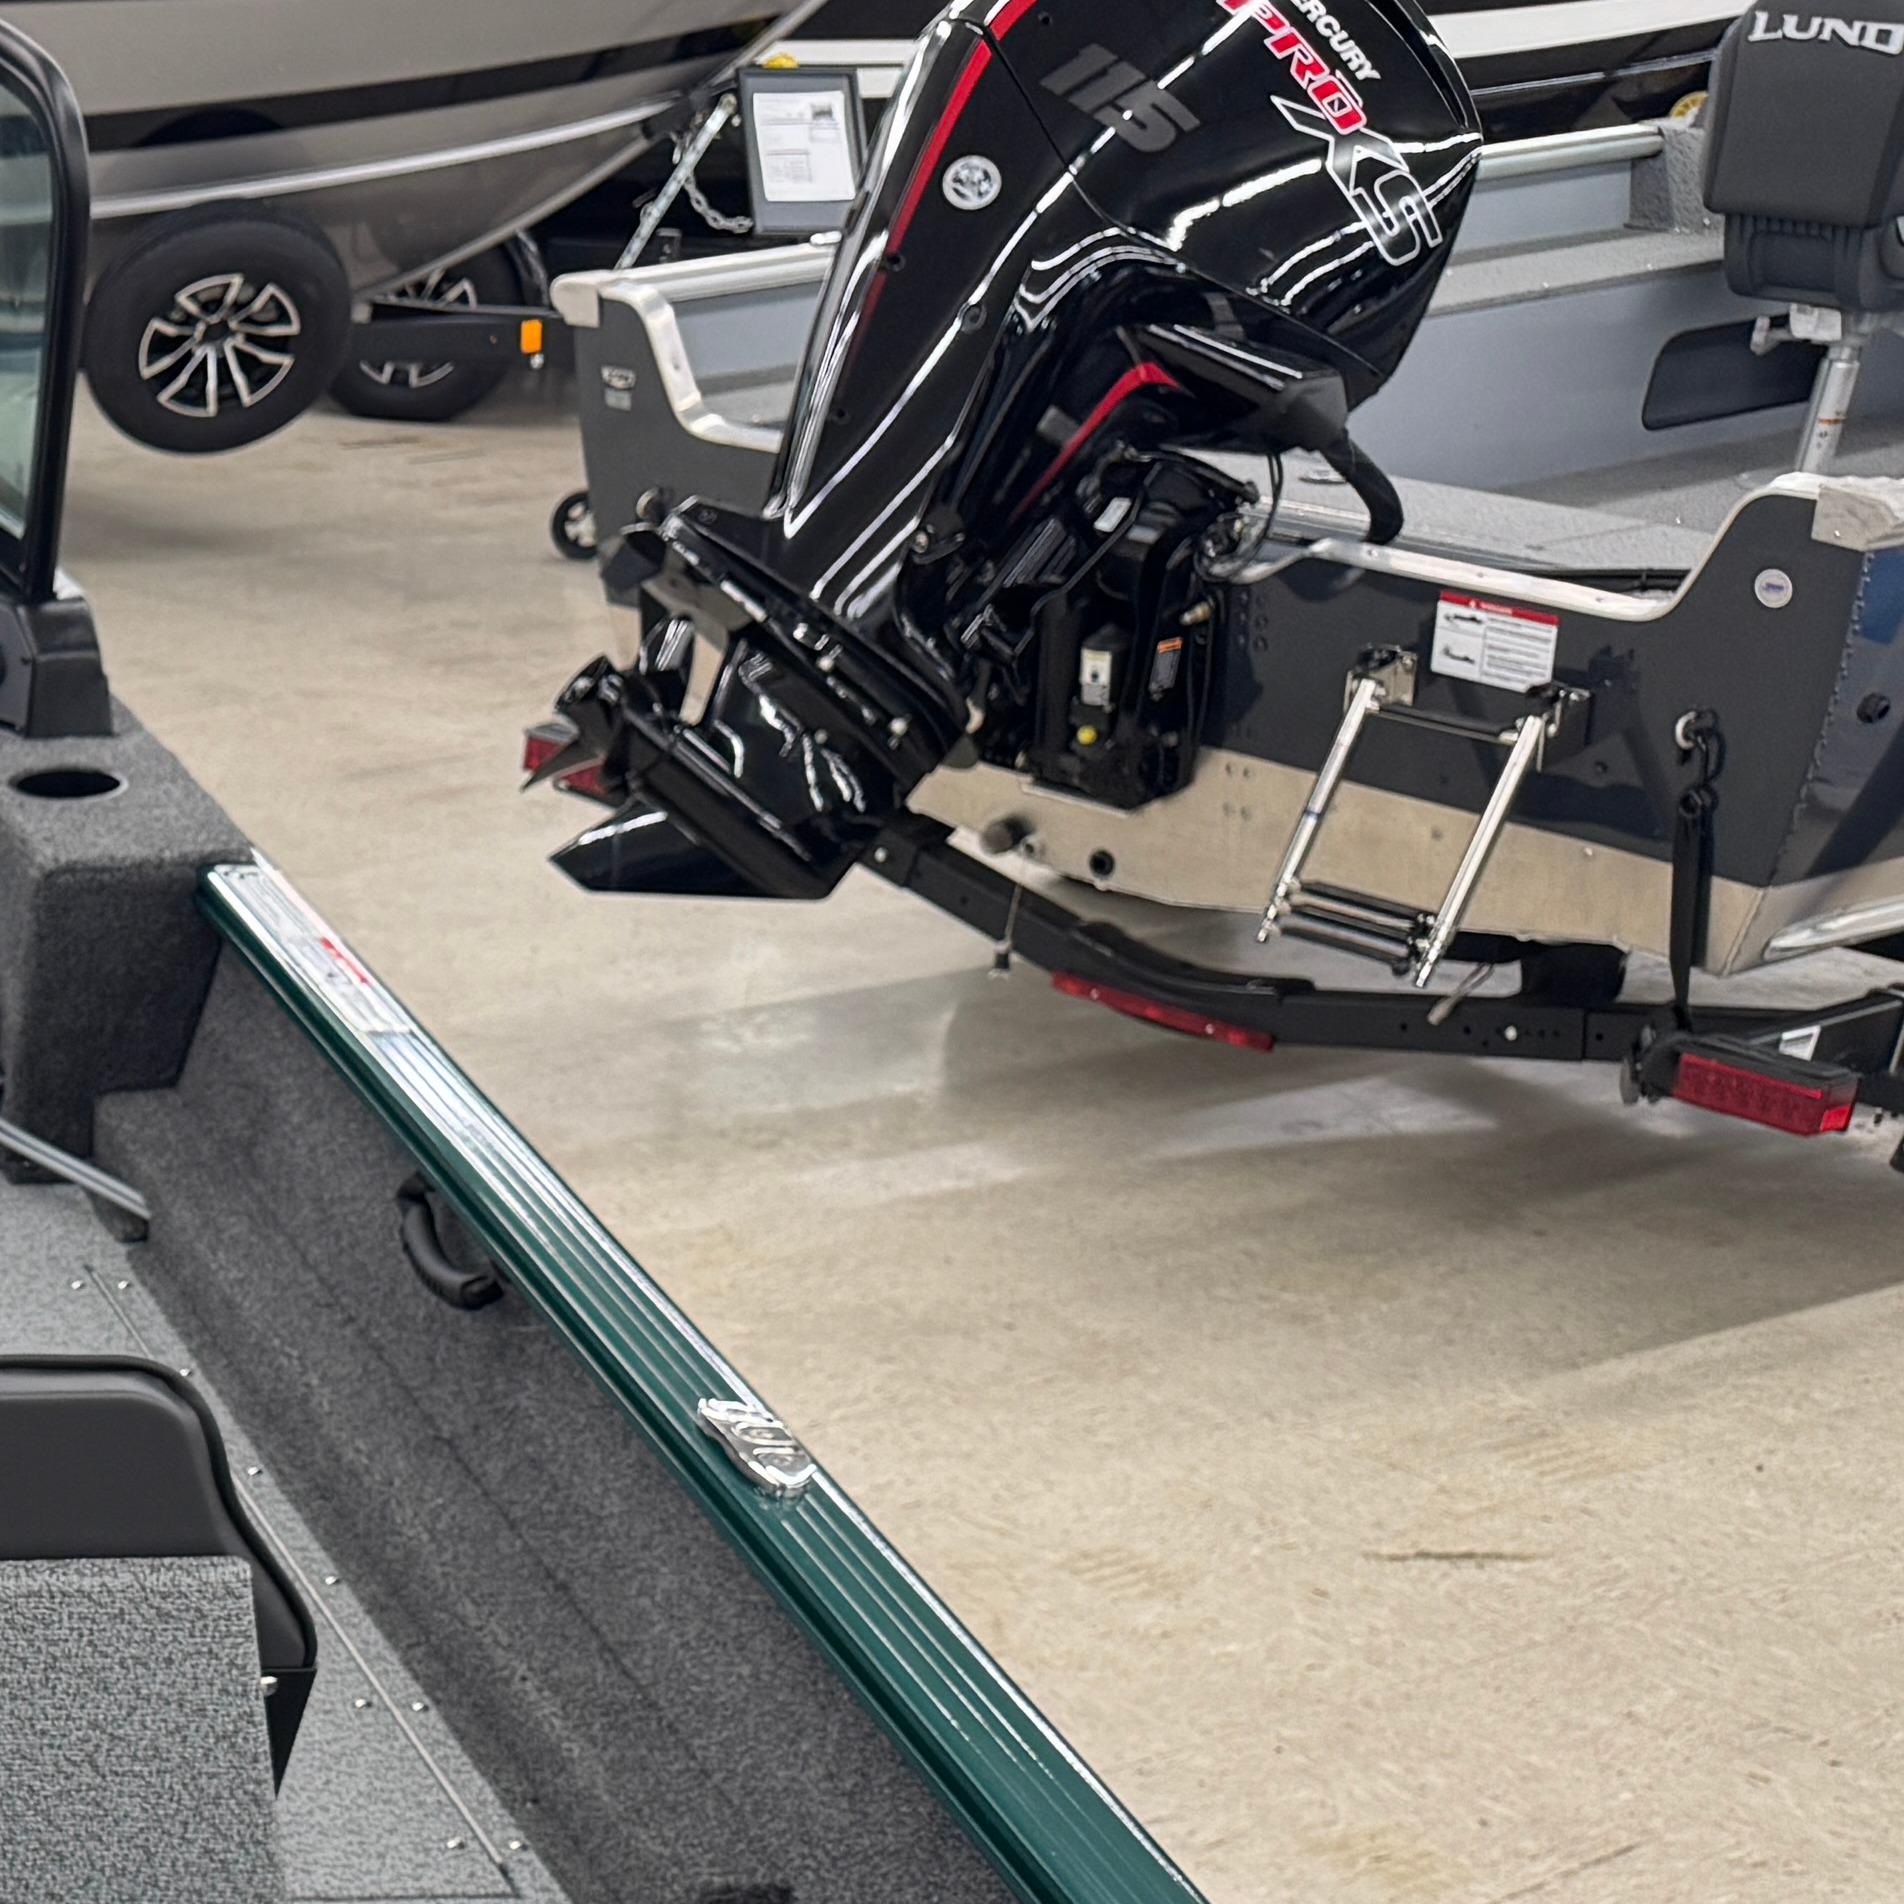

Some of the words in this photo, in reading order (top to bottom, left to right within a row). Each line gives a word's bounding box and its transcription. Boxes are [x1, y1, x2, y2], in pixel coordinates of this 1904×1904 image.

[1748, 10, 1904, 55] LUND
[1040, 43, 1200, 152] 115
[1270, 95, 1442, 266] XS
